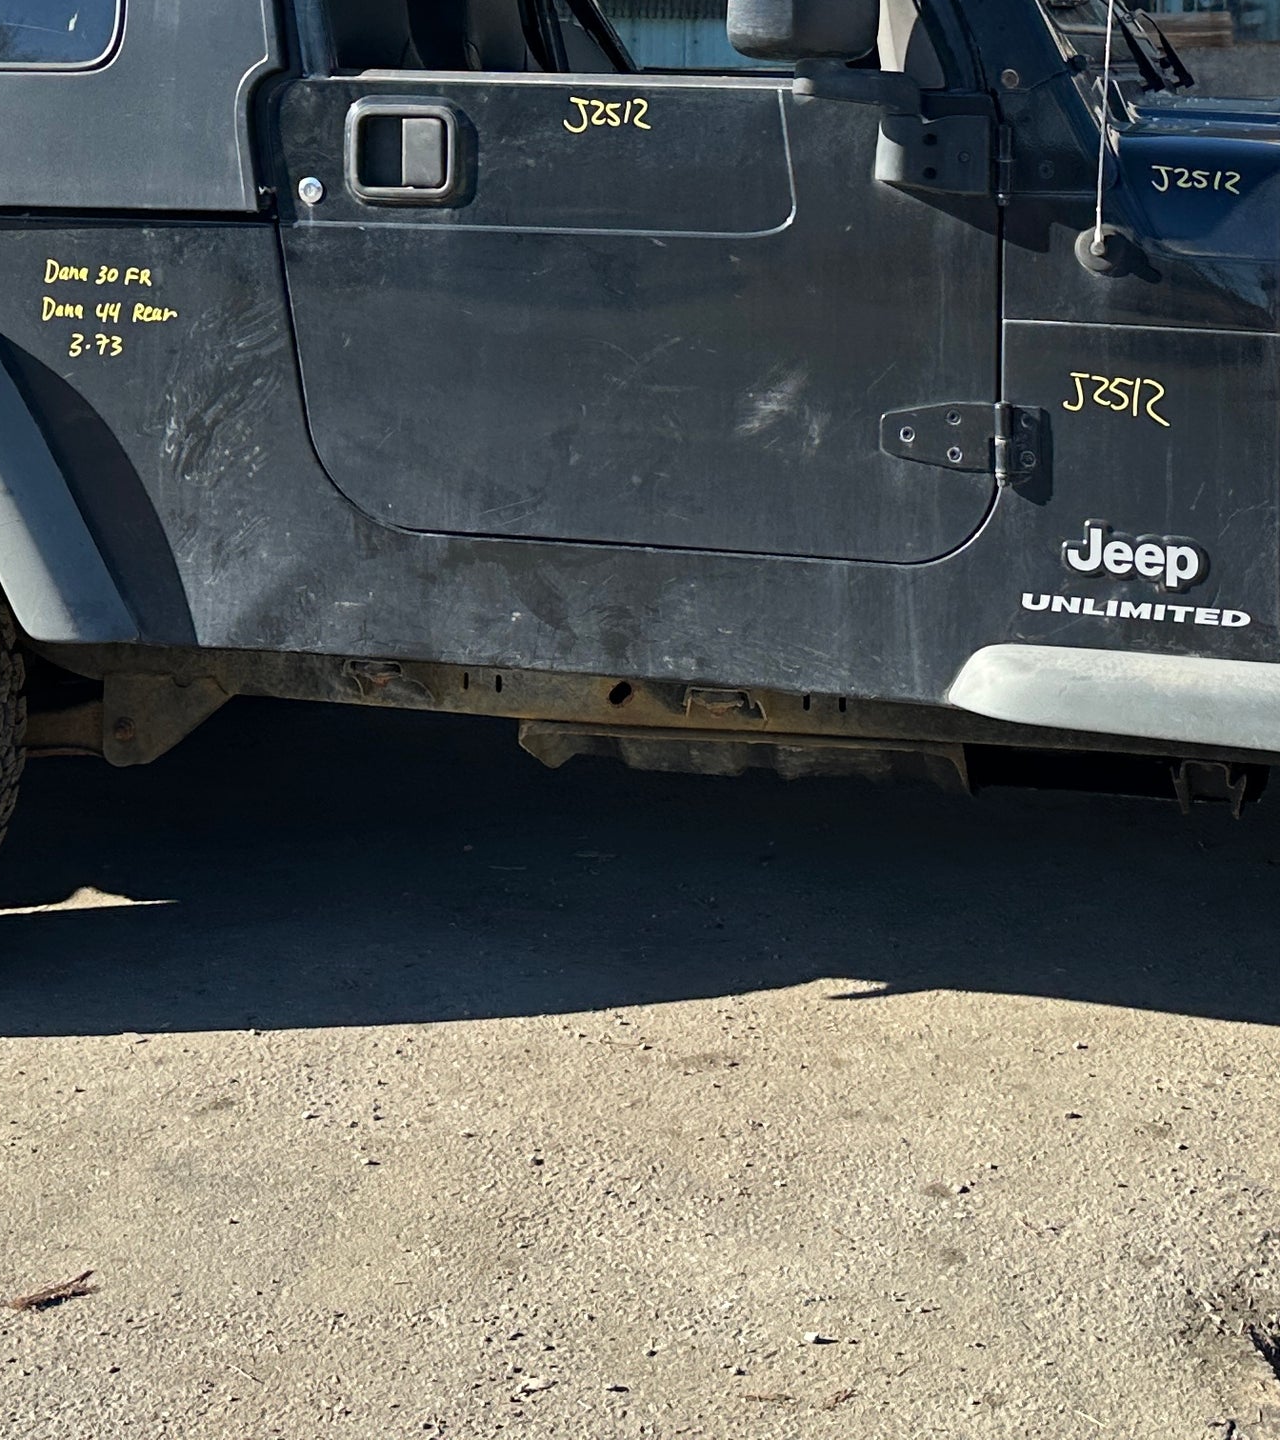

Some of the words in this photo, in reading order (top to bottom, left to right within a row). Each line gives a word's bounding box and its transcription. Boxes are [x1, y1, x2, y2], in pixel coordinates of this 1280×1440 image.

[563, 96, 652, 134] J2512
[1151, 164, 1242, 195] J2512
[44, 258, 89, 284] Dana
[95, 265, 119, 285] 30
[124, 266, 153, 287] FR
[41, 296, 84, 321] Dana
[95, 301, 122, 323] 44
[131, 302, 179, 324] Rear
[68, 332, 124, 358] 3.73
[1062, 371, 1171, 428] J2512
[1066, 527, 1200, 588] Jeep
[1020, 591, 1252, 628] UNLIMITED
